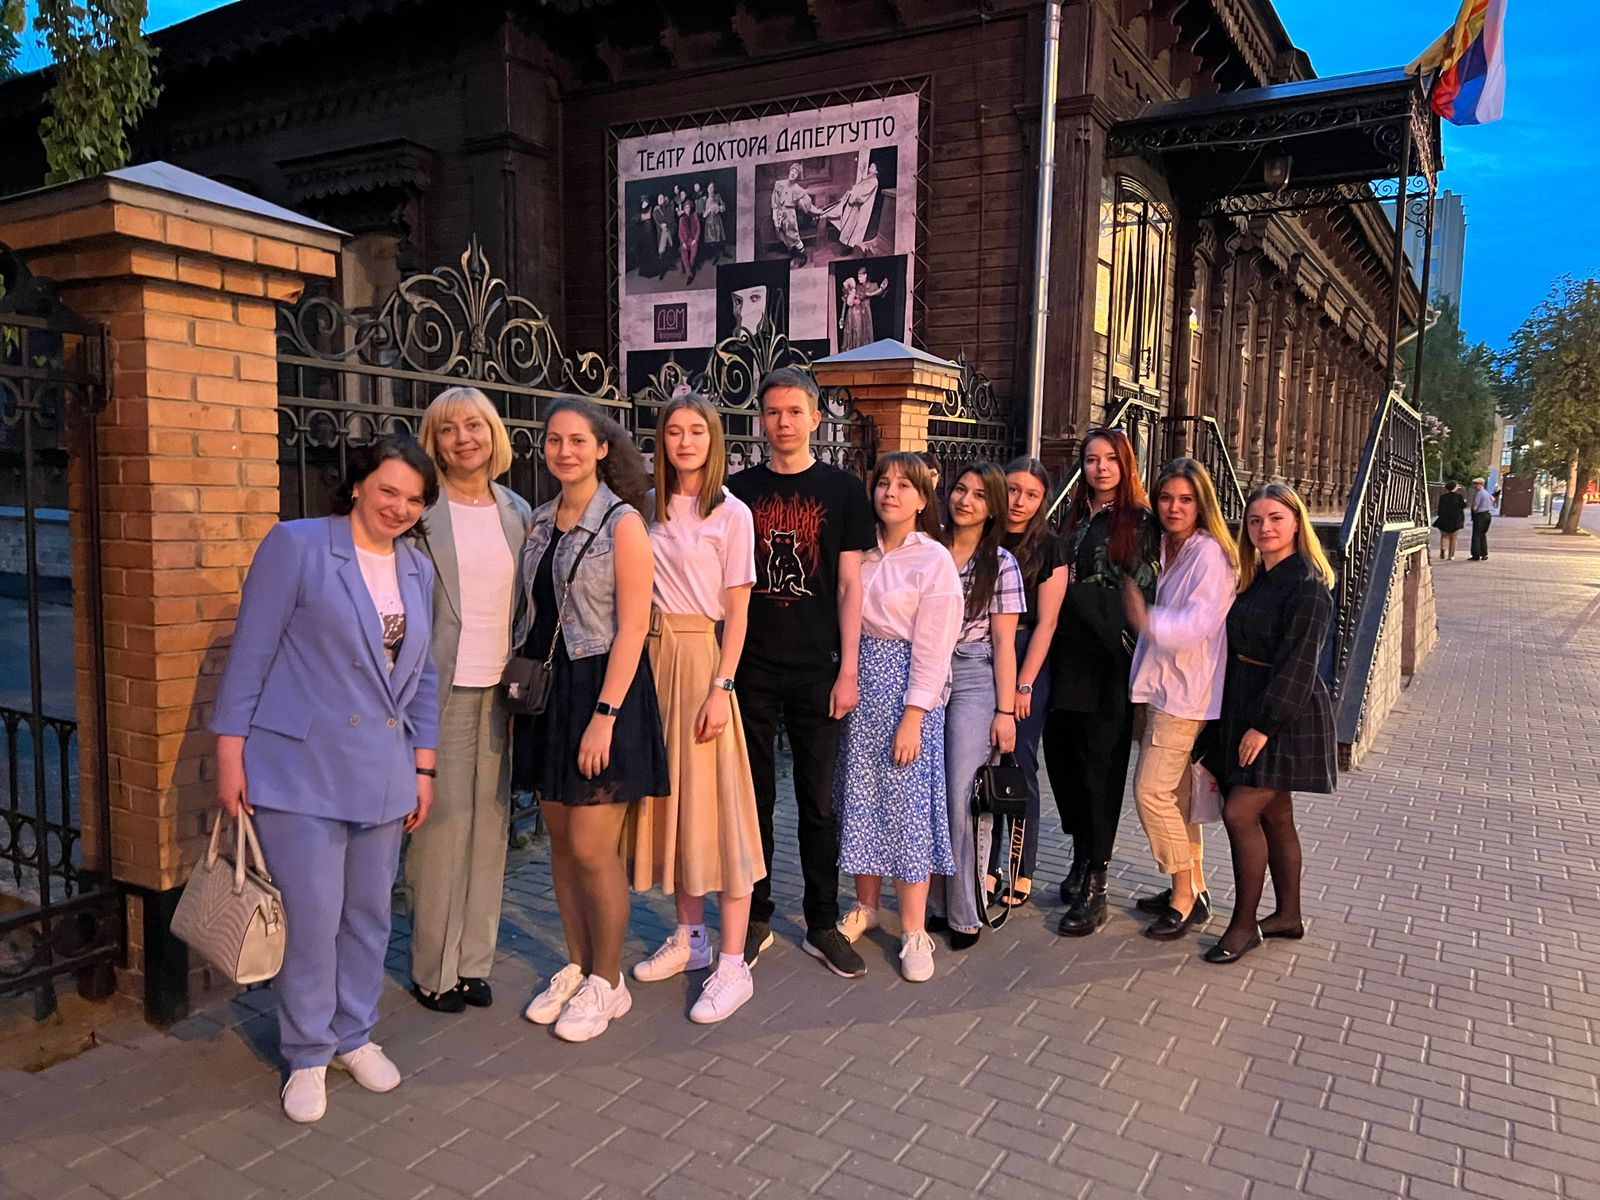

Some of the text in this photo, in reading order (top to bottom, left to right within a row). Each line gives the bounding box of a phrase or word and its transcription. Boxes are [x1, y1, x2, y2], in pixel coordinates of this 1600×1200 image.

[637, 115, 896, 171] ТЕАТР ДОКТОРА ДАПЕРТУТТО
